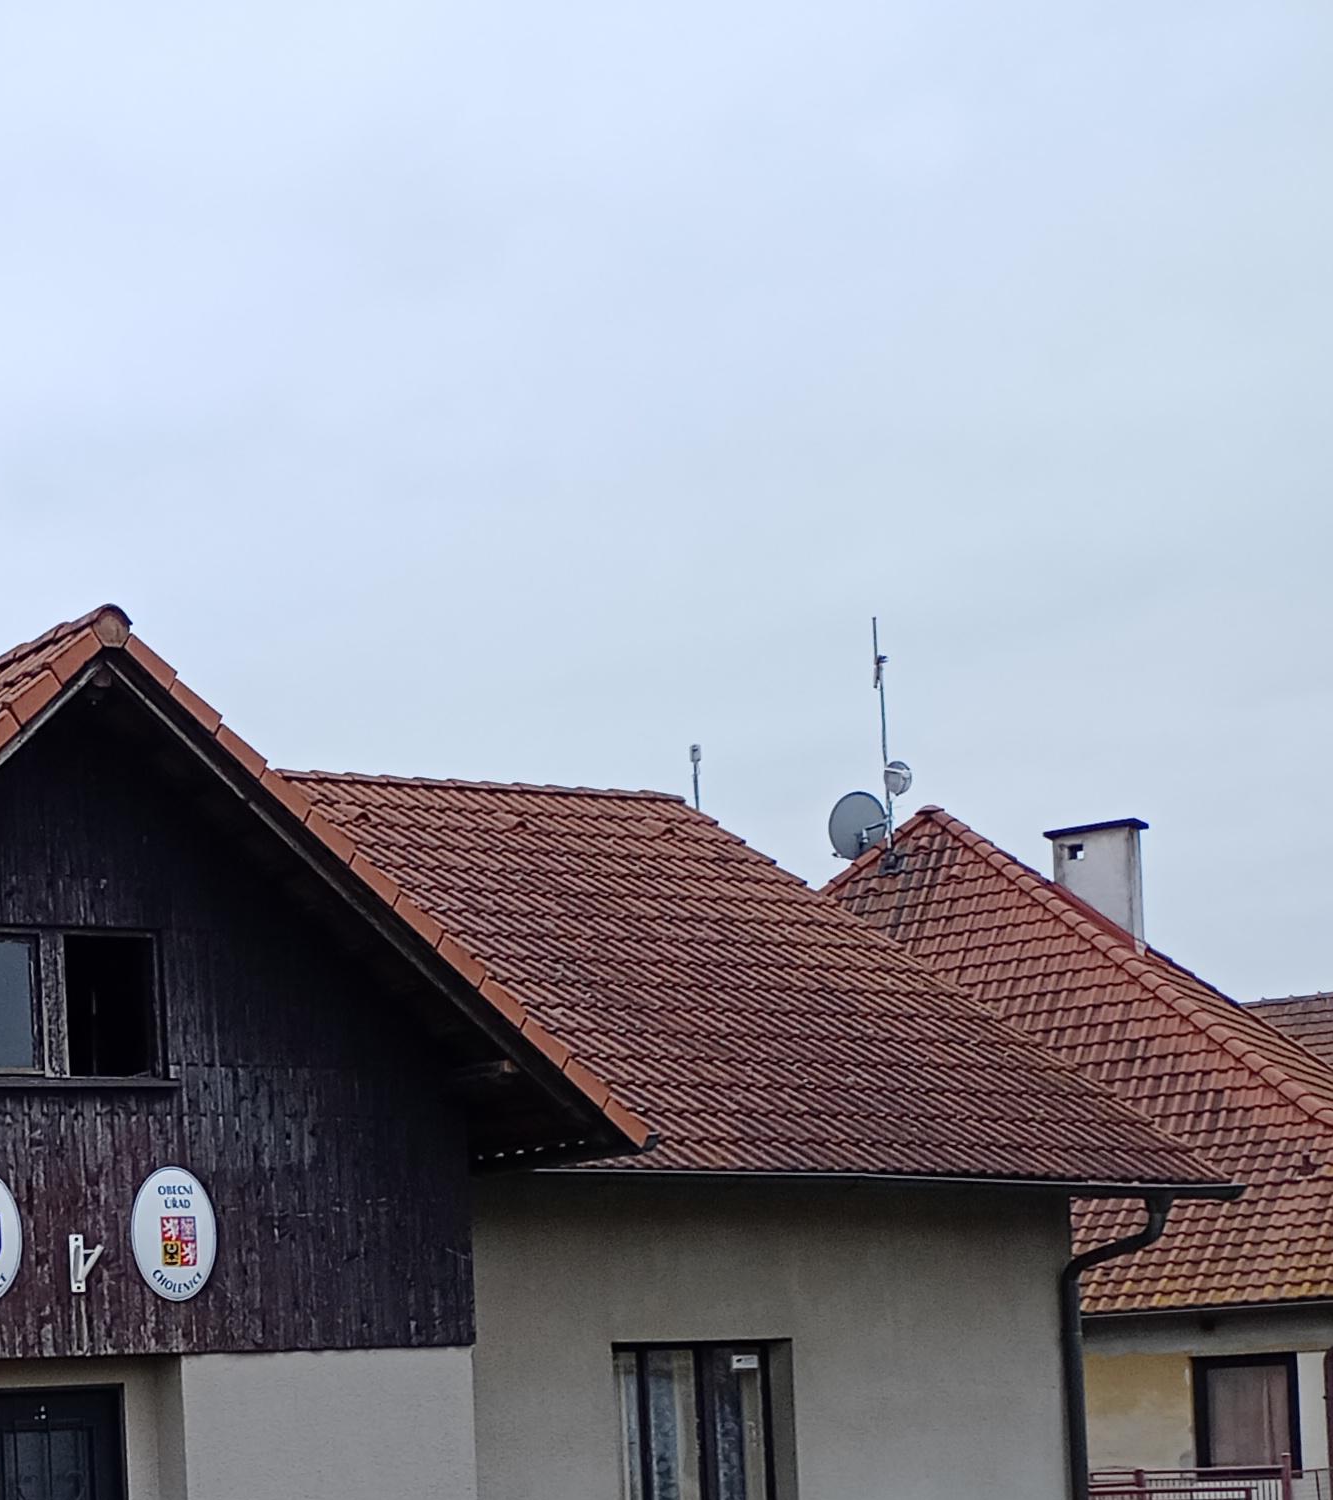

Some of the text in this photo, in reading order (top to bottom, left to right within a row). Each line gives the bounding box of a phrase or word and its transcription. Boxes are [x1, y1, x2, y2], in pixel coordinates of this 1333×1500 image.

[157, 1184, 193, 1195] OBECNÍ
[164, 1197, 191, 1209] ÚŘAD
[152, 1269, 202, 1293] CHOLENICE
